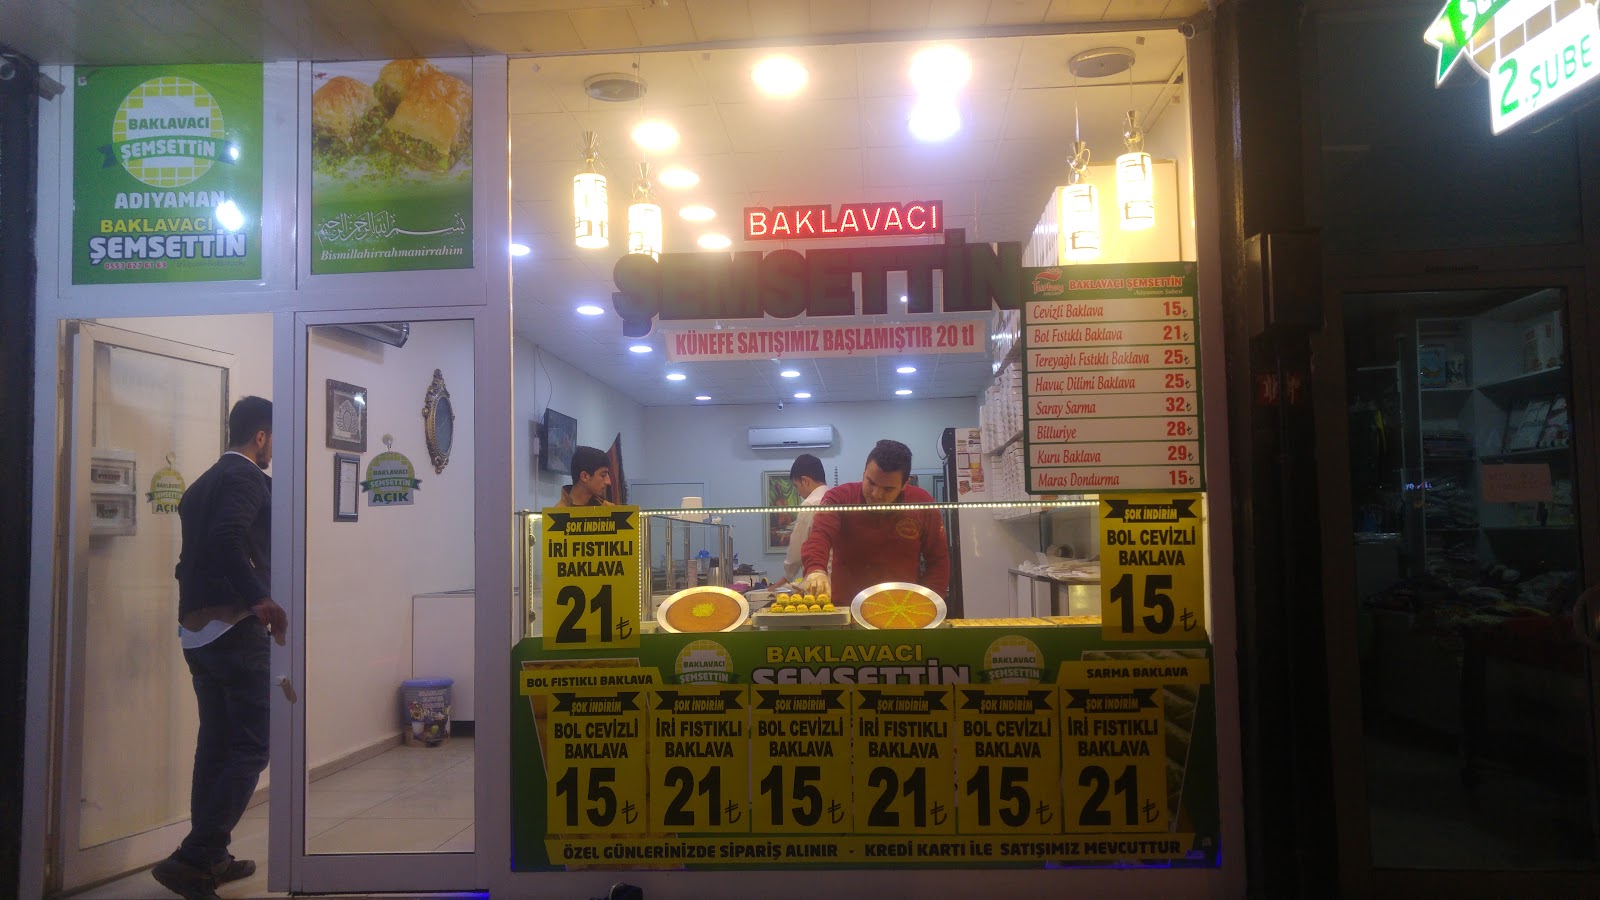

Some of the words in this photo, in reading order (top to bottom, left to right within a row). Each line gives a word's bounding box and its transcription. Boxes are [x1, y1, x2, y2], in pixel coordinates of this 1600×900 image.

[128, 116, 210, 130] BAKLAVACI
[120, 139, 216, 163] ŞEMSETTİN
[114, 190, 225, 209] ADIYAMAN
[100, 217, 213, 233] BAKLAVACI
[750, 205, 937, 236] BAKLAVACI
[89, 229, 246, 265] ŞEMSETTİN
[320, 245, 463, 261] Bismillahirrahmanirrahim
[612, 228, 1022, 338] ŞEMSETTİN
[1069, 278, 1124, 290] BAKLAVACI
[1126, 275, 1182, 291] ŞEMSETTİN
[1034, 304, 1063, 320] Cevizli
[1066, 304, 1104, 318] Baklava
[675, 328, 734, 356] KÜNEFE
[738, 325, 819, 359] SATIŞIMIZ
[823, 322, 932, 356] BAŞLAMIŞTIR
[937, 325, 960, 347] 20
[1034, 330, 1049, 343] Bol
[1052, 328, 1082, 342] Fıstıklı
[1085, 328, 1122, 341] Baklava
[1035, 353, 1076, 370] Tereyağlı
[1078, 352, 1109, 366] Fıstıklı
[1112, 351, 1150, 365] Baklava
[1036, 378, 1064, 394] Havuç
[1066, 376, 1095, 390] Dilimi
[1098, 376, 1136, 390] Baklava
[1036, 402, 1063, 418] Saray
[1065, 401, 1096, 415] Sarma
[1036, 426, 1076, 442] Billuriye
[1037, 450, 1060, 464] Kuru
[1063, 449, 1101, 463] Baklava
[1070, 473, 1120, 487] Dondurma
[372, 492, 409, 504] AÇIK
[1124, 508, 1142, 522] ŞOK
[1144, 505, 1178, 520] İNDİRİM
[566, 521, 582, 536] ŞOK
[584, 518, 616, 533] İNDİRİM
[1107, 530, 1136, 546] BOL
[1140, 526, 1196, 546] CEVİZLİ
[548, 538, 568, 557] İRİ
[572, 540, 633, 556] FISTIKLI
[1119, 550, 1185, 566] BAKLAVA
[557, 560, 624, 578] BAKLAVA
[766, 644, 923, 664] BAKLAVACI
[992, 656, 1036, 664] BAKLAVACI
[683, 660, 726, 668] BAKLAVACI
[1086, 668, 1131, 679] SARMA
[1132, 666, 1189, 678] BAKLAVA
[526, 678, 548, 688] BOL
[550, 676, 598, 687] FISTIKLI
[600, 674, 653, 686] BAKLAVA
[570, 700, 588, 714] ŞOK
[588, 697, 622, 713] İNDİRİM
[674, 699, 690, 713] ŞOK
[691, 695, 724, 712] İNDİRİM
[775, 698, 792, 712] ŞOK
[793, 695, 826, 711] İNDİRİM
[980, 698, 997, 714] ŞOK
[998, 696, 1033, 712] İNDİRİM
[1085, 697, 1103, 712] ŞOK
[1104, 693, 1139, 710] İNDİRİM
[554, 722, 582, 738] BOL
[585, 718, 638, 738] CEVİZLİ
[656, 719, 676, 738] İRİ
[680, 720, 742, 737] FISTIKLI
[758, 720, 786, 737] BOL
[789, 716, 844, 737] CEVİZLİ
[860, 717, 878, 736] İRİ
[884, 721, 948, 738] FISTIKLI
[964, 720, 993, 736] BOL
[995, 717, 1052, 738] CEVİZLİ
[1068, 716, 1088, 736] İRİ
[1094, 718, 1158, 736] FISTIKLI
[564, 742, 628, 759] BAKLAVA
[665, 742, 734, 758] BAKLAVA
[769, 740, 833, 758] BAKLAVA
[868, 742, 939, 758] BAKLAVA
[975, 741, 1041, 758] BAKLAVA
[1078, 740, 1150, 757] BAKLAVA
[563, 844, 600, 860] ÖZEL
[604, 843, 716, 860] GÜNLERİNİZDE
[720, 841, 782, 860] SİPARİŞ
[785, 844, 838, 858] ALINIR
[864, 840, 914, 857] KREDİ
[918, 842, 966, 857] KARTI
[969, 839, 993, 856] İLE
[1000, 842, 1080, 858] SATIŞIMIZ
[1084, 840, 1180, 856] MEVCUTTUR
